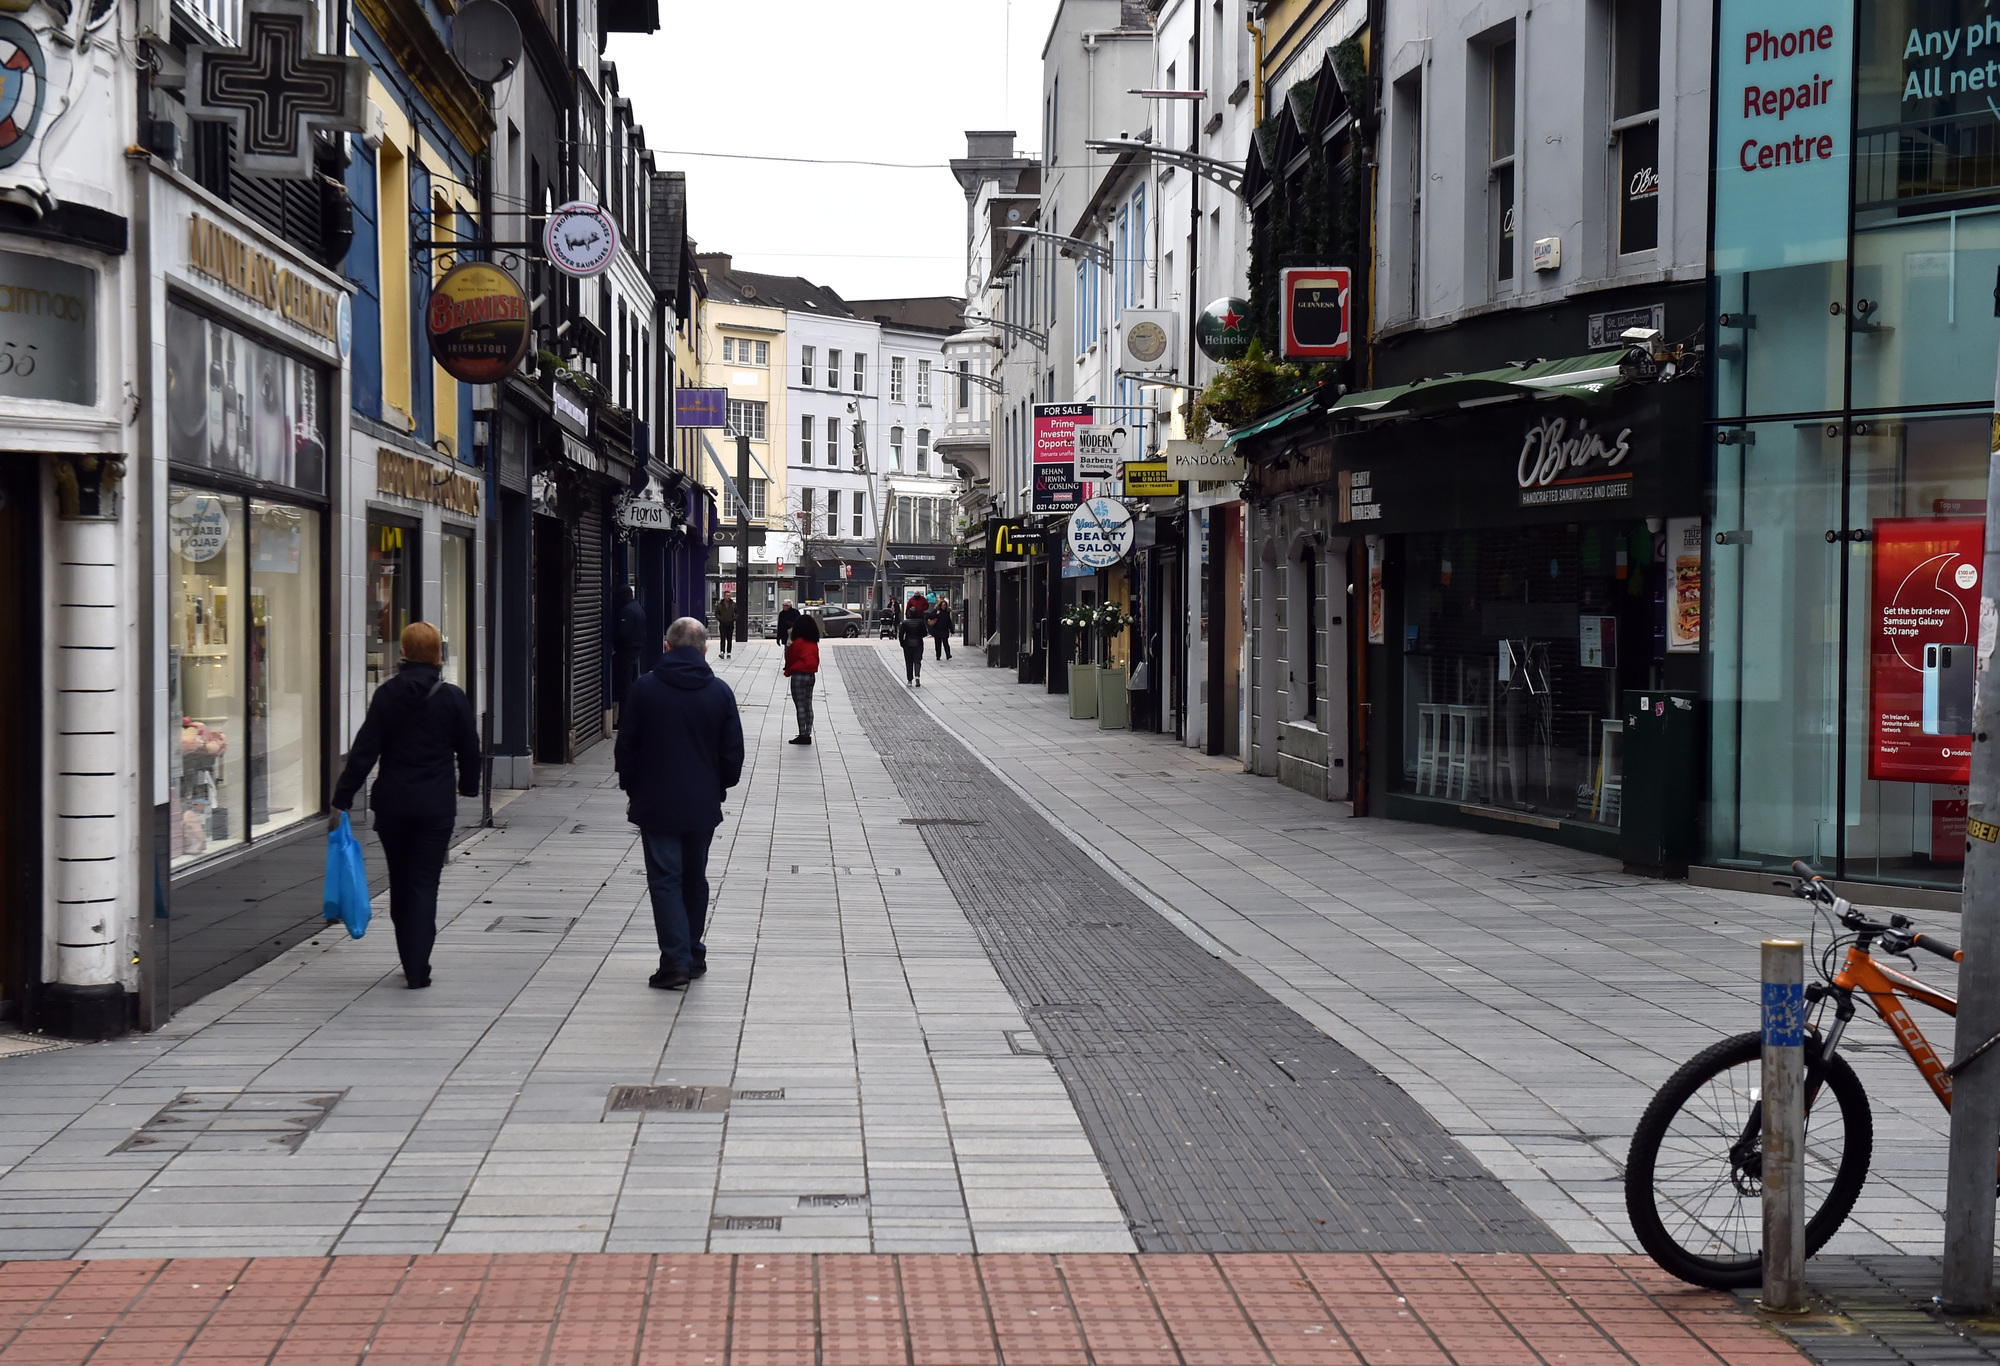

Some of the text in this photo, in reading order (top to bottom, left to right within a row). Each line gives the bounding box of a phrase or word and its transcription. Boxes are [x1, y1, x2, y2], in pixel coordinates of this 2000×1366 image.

[1745, 25, 1833, 65] Phone
[1902, 28, 1960, 60] Any
[1901, 60, 2000, 102] All net
[1743, 73, 1833, 121] Repair
[1739, 135, 1833, 172] Centre
[553, 242, 609, 269] PROPER SAUSAGES
[430, 293, 526, 335] BEAMISH
[448, 343, 508, 354] IRISH STOUT
[1044, 406, 1083, 416] FOR SALE
[1051, 420, 1074, 428] Prime
[1079, 434, 1113, 447] MODERN
[1518, 416, 1632, 487] O'Briens
[1080, 456, 1113, 464] Barbers
[1175, 453, 1236, 466] PANDORA
[1036, 476, 1047, 490] &
[1045, 475, 1066, 483] IRWIN
[1522, 483, 1628, 504] HANDCRAFTED SANDWICHES AND COFFEE
[630, 506, 663, 523] Florist
[1074, 532, 1127, 541] BEAUTY
[1077, 543, 1121, 552] SALON
[1883, 607, 1951, 615] Get the brand-new
[1883, 617, 1944, 627] Samsung Galaxy
[1883, 627, 1919, 637] S20 range
[1880, 746, 1899, 754] Ready?
